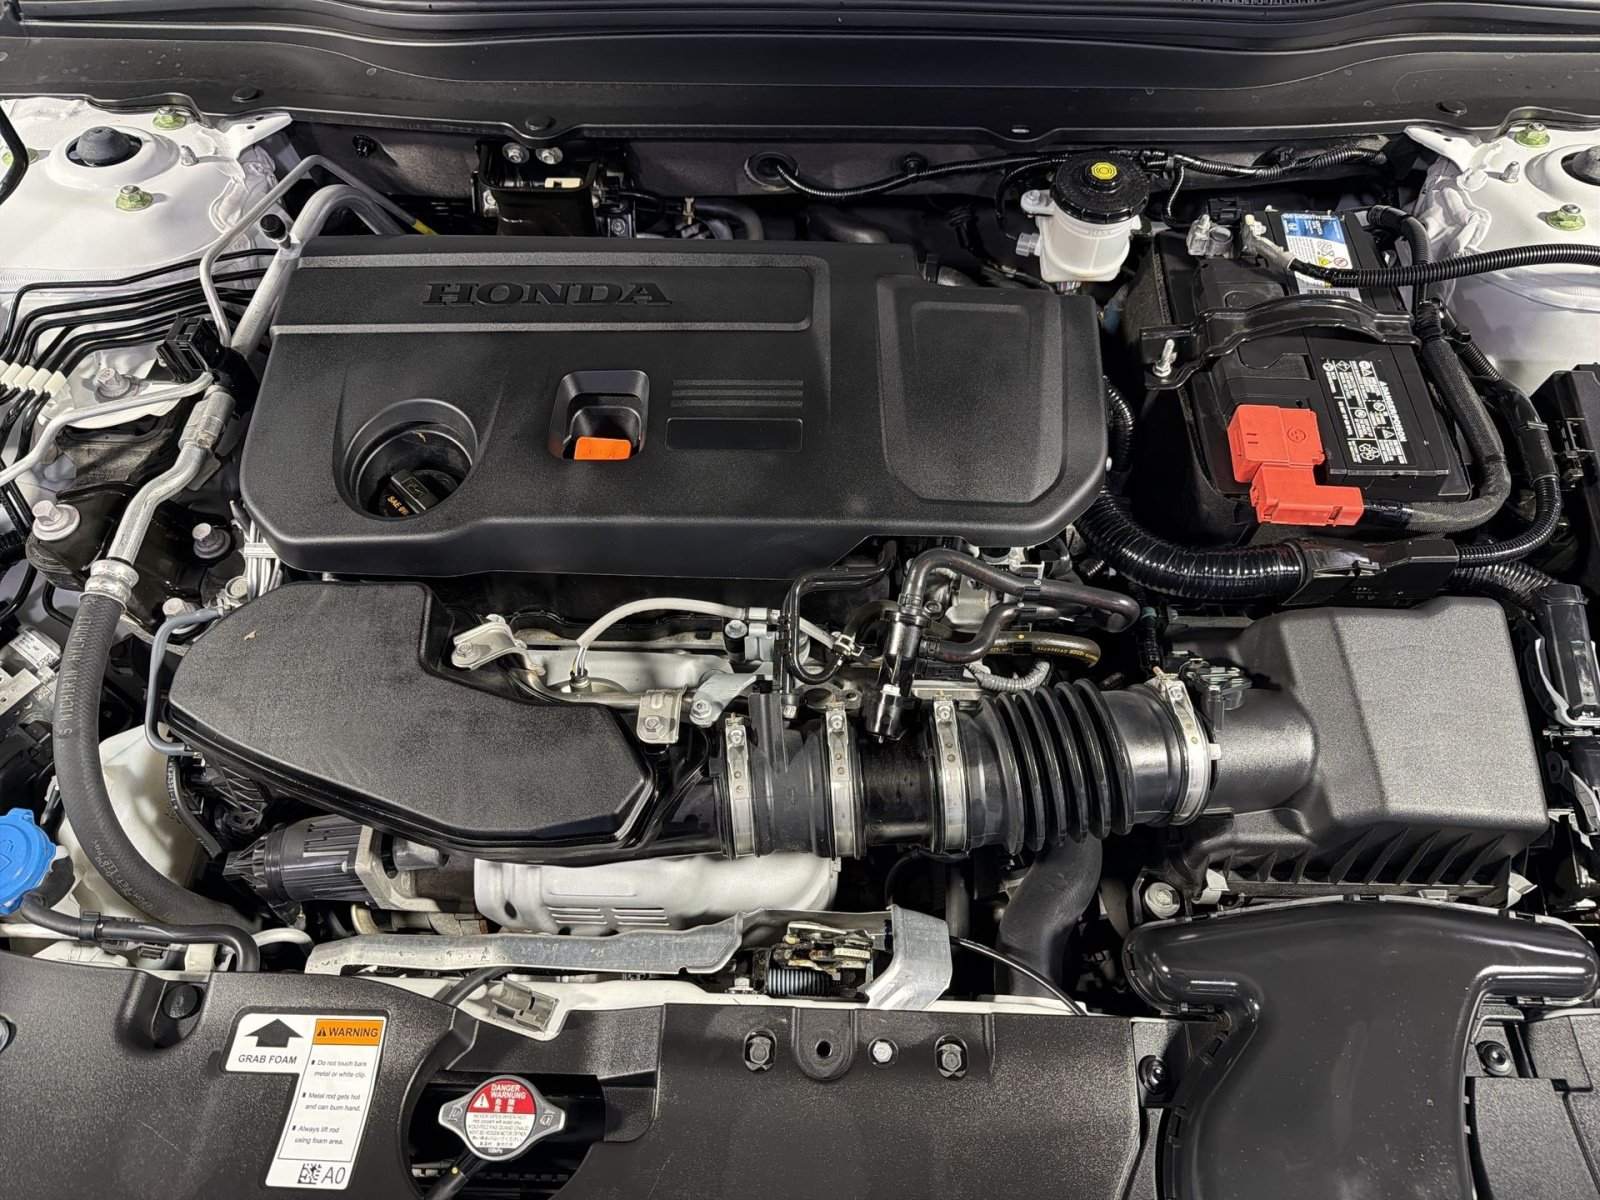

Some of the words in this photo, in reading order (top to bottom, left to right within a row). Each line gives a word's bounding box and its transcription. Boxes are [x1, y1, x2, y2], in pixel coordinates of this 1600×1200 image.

[422, 282, 672, 306] HONDA
[387, 496, 402, 509] SAE
[60, 670, 79, 722] NICHIRIN
[329, 1028, 378, 1038] WARNING
[238, 1055, 266, 1063] GRAB
[268, 1056, 297, 1064] FOAM
[298, 1126, 319, 1134] Always
[295, 1137, 311, 1145] using
